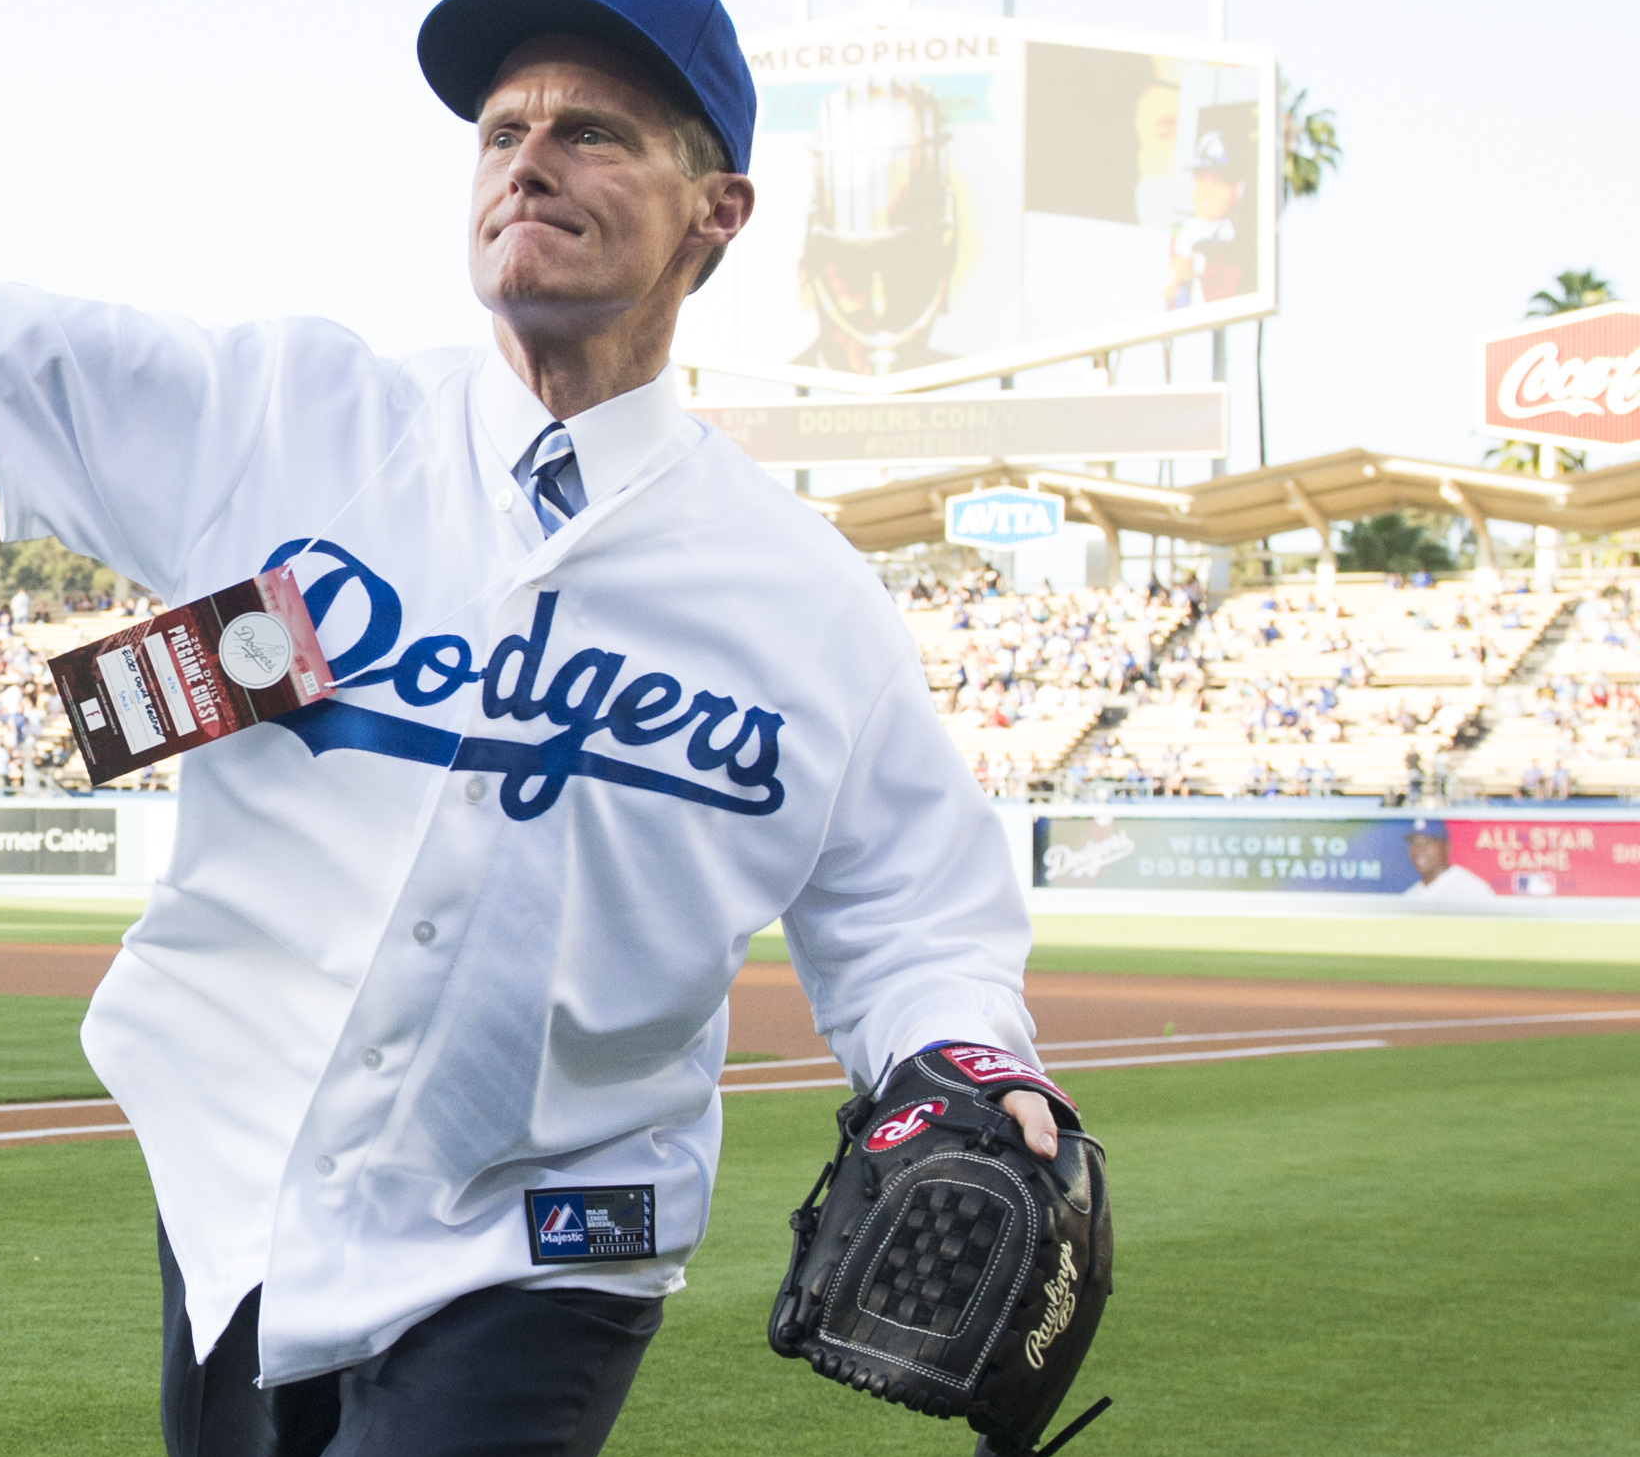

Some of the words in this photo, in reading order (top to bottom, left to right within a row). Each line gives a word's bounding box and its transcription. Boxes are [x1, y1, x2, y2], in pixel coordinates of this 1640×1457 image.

[750, 35, 1002, 71] MICROPHONE
[955, 501, 1054, 535] AVITA
[234, 626, 277, 673] Dodgers
[168, 624, 204, 686] PREGAME
[190, 685, 220, 724] GUEST
[191, 636, 207, 664] 2014
[203, 669, 221, 703] DAILY
[260, 538, 786, 822] Dodgers
[44, 828, 110, 852] Cable
[1043, 830, 1135, 880] Dodgers
[1169, 837, 1303, 856] WELCOME
[1313, 838, 1349, 856] TO
[1476, 828, 1522, 850] ALL
[1528, 827, 1595, 851] STAR
[1137, 859, 1248, 878] DODGER
[1259, 860, 1382, 880] STADIUM
[1497, 849, 1571, 872] GAME
[540, 1232, 584, 1245] Majestic
[1025, 1240, 1078, 1370] Rawlings
